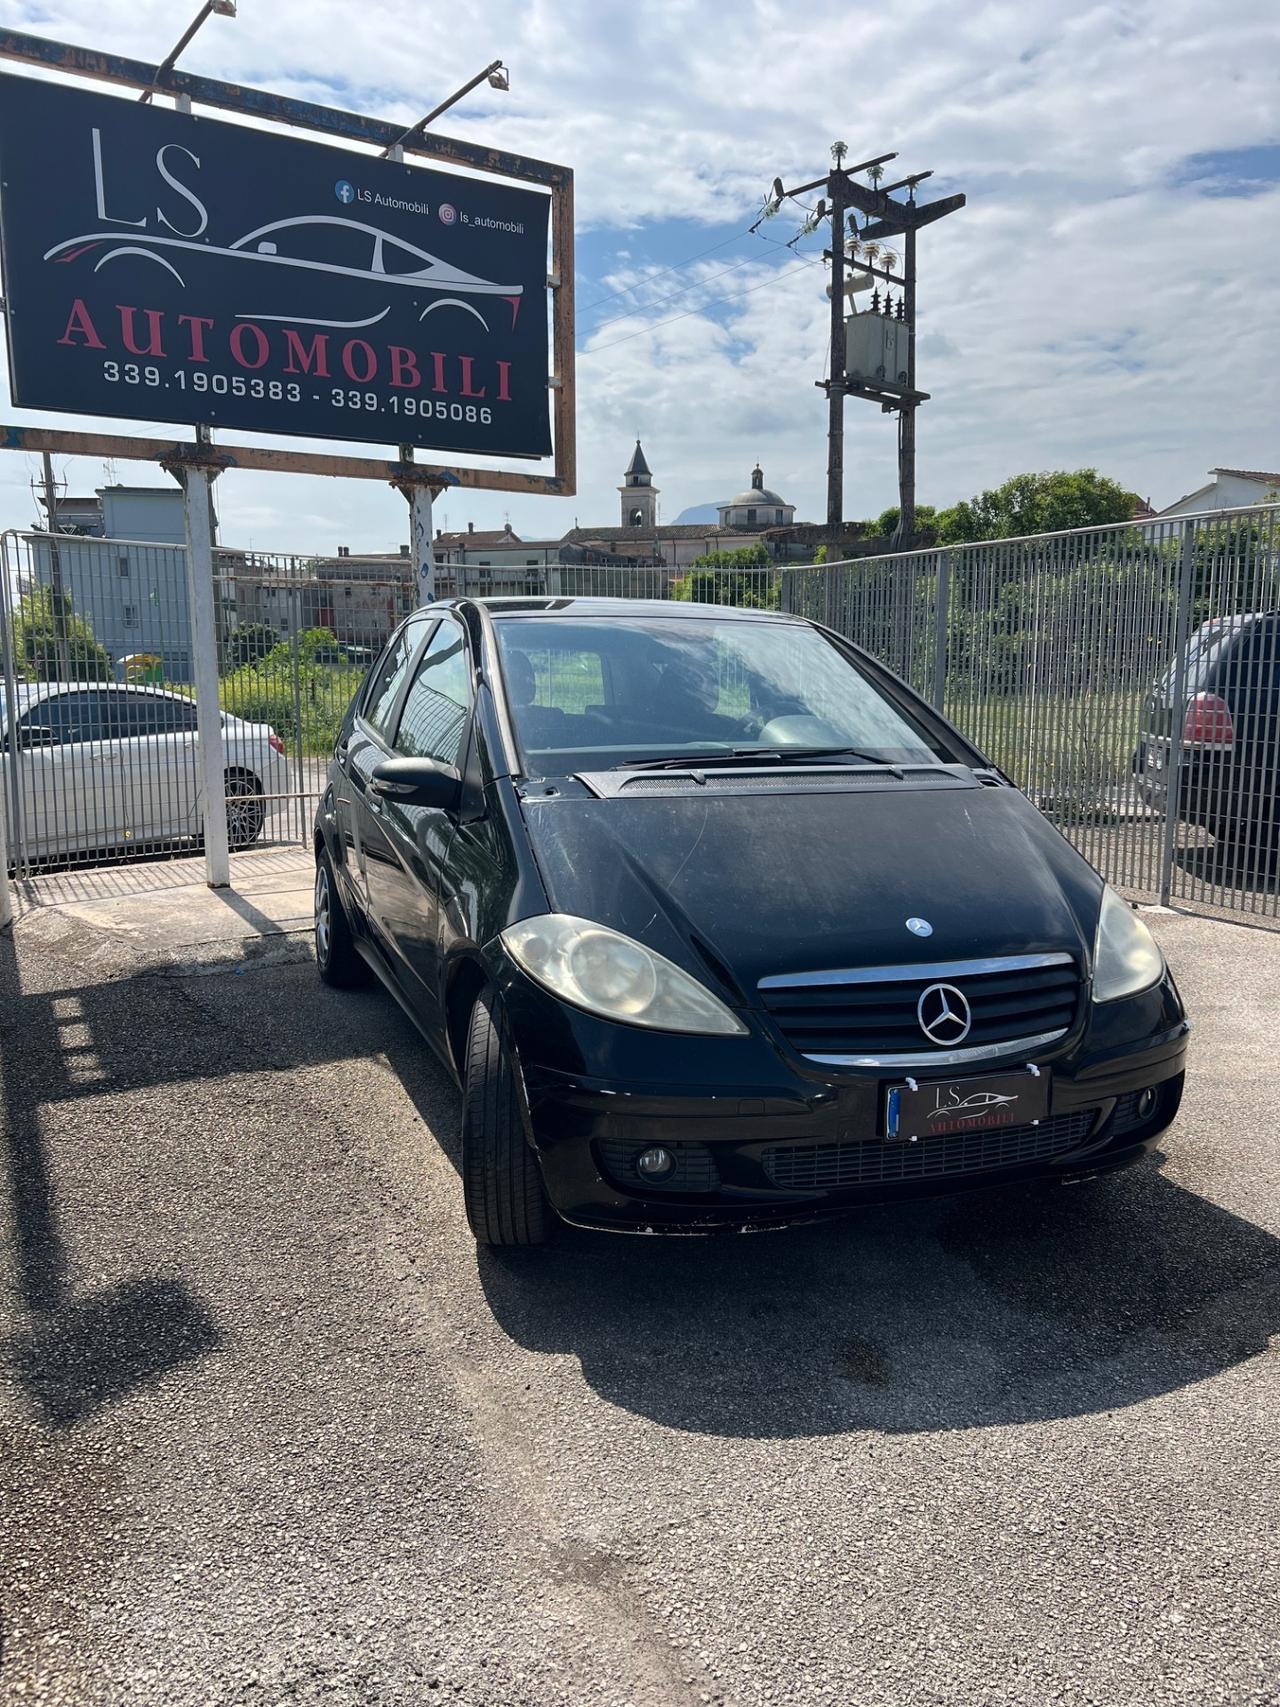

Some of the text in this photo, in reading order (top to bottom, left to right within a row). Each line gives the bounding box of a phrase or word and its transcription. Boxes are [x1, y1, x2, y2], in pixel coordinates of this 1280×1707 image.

[92, 127, 208, 238] LS
[357, 188, 429, 215] LS Automobili
[56, 299, 512, 401] AUTOMOBILI
[103, 361, 300, 402] 339.1905383
[331, 388, 492, 424] 339.1905086
[936, 1086, 960, 1109] LS
